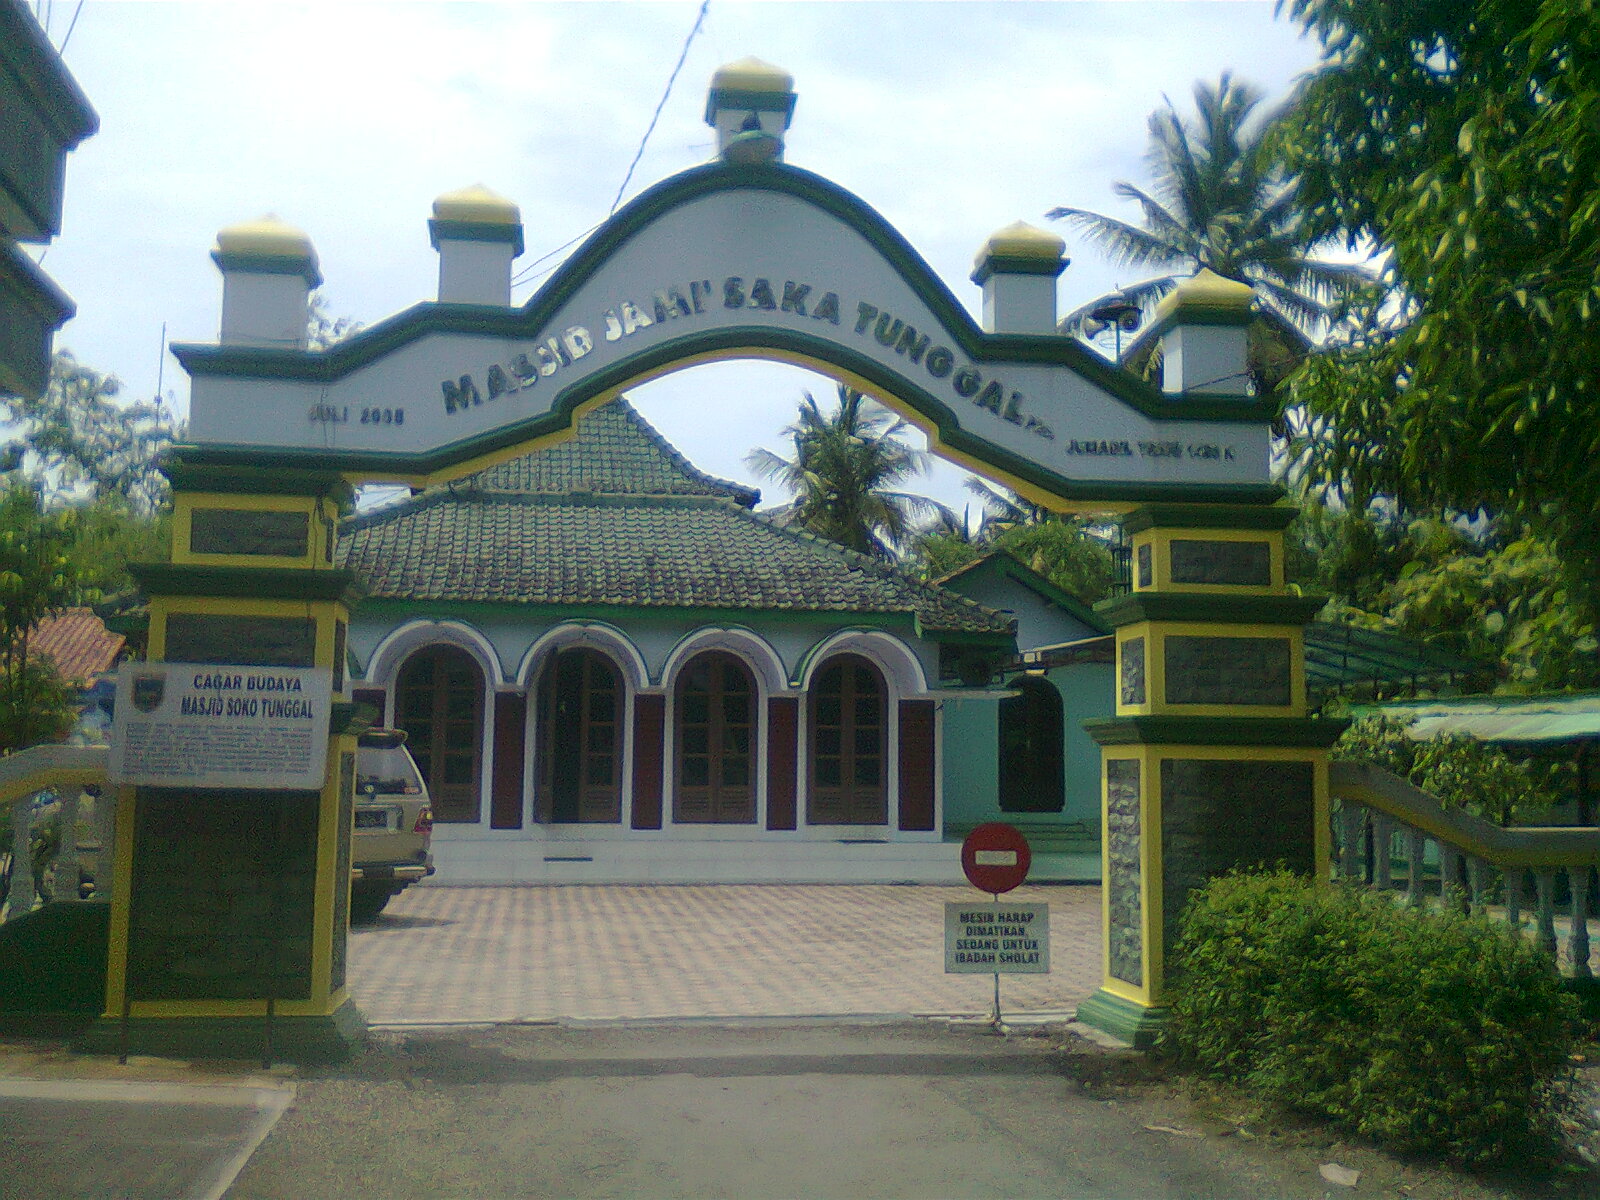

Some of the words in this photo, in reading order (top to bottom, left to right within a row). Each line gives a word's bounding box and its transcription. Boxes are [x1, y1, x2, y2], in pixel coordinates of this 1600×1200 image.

[441, 324, 595, 416] MASJID
[723, 276, 842, 326] SAKA
[854, 300, 1024, 428] TUNGGAL
[193, 673, 242, 691] CAGAR
[246, 676, 302, 692] BUDAYA
[181, 695, 224, 717] MASJID
[226, 698, 258, 718] SOKO
[262, 698, 313, 719] TUNGGAL
[960, 912, 994, 923] MESIN
[998, 912, 1034, 923] HARAP
[957, 940, 999, 950] SEDANG
[1002, 939, 1039, 950] UNTUK
[955, 952, 995, 964] IBADAH
[999, 952, 1040, 964] SHOLAT
